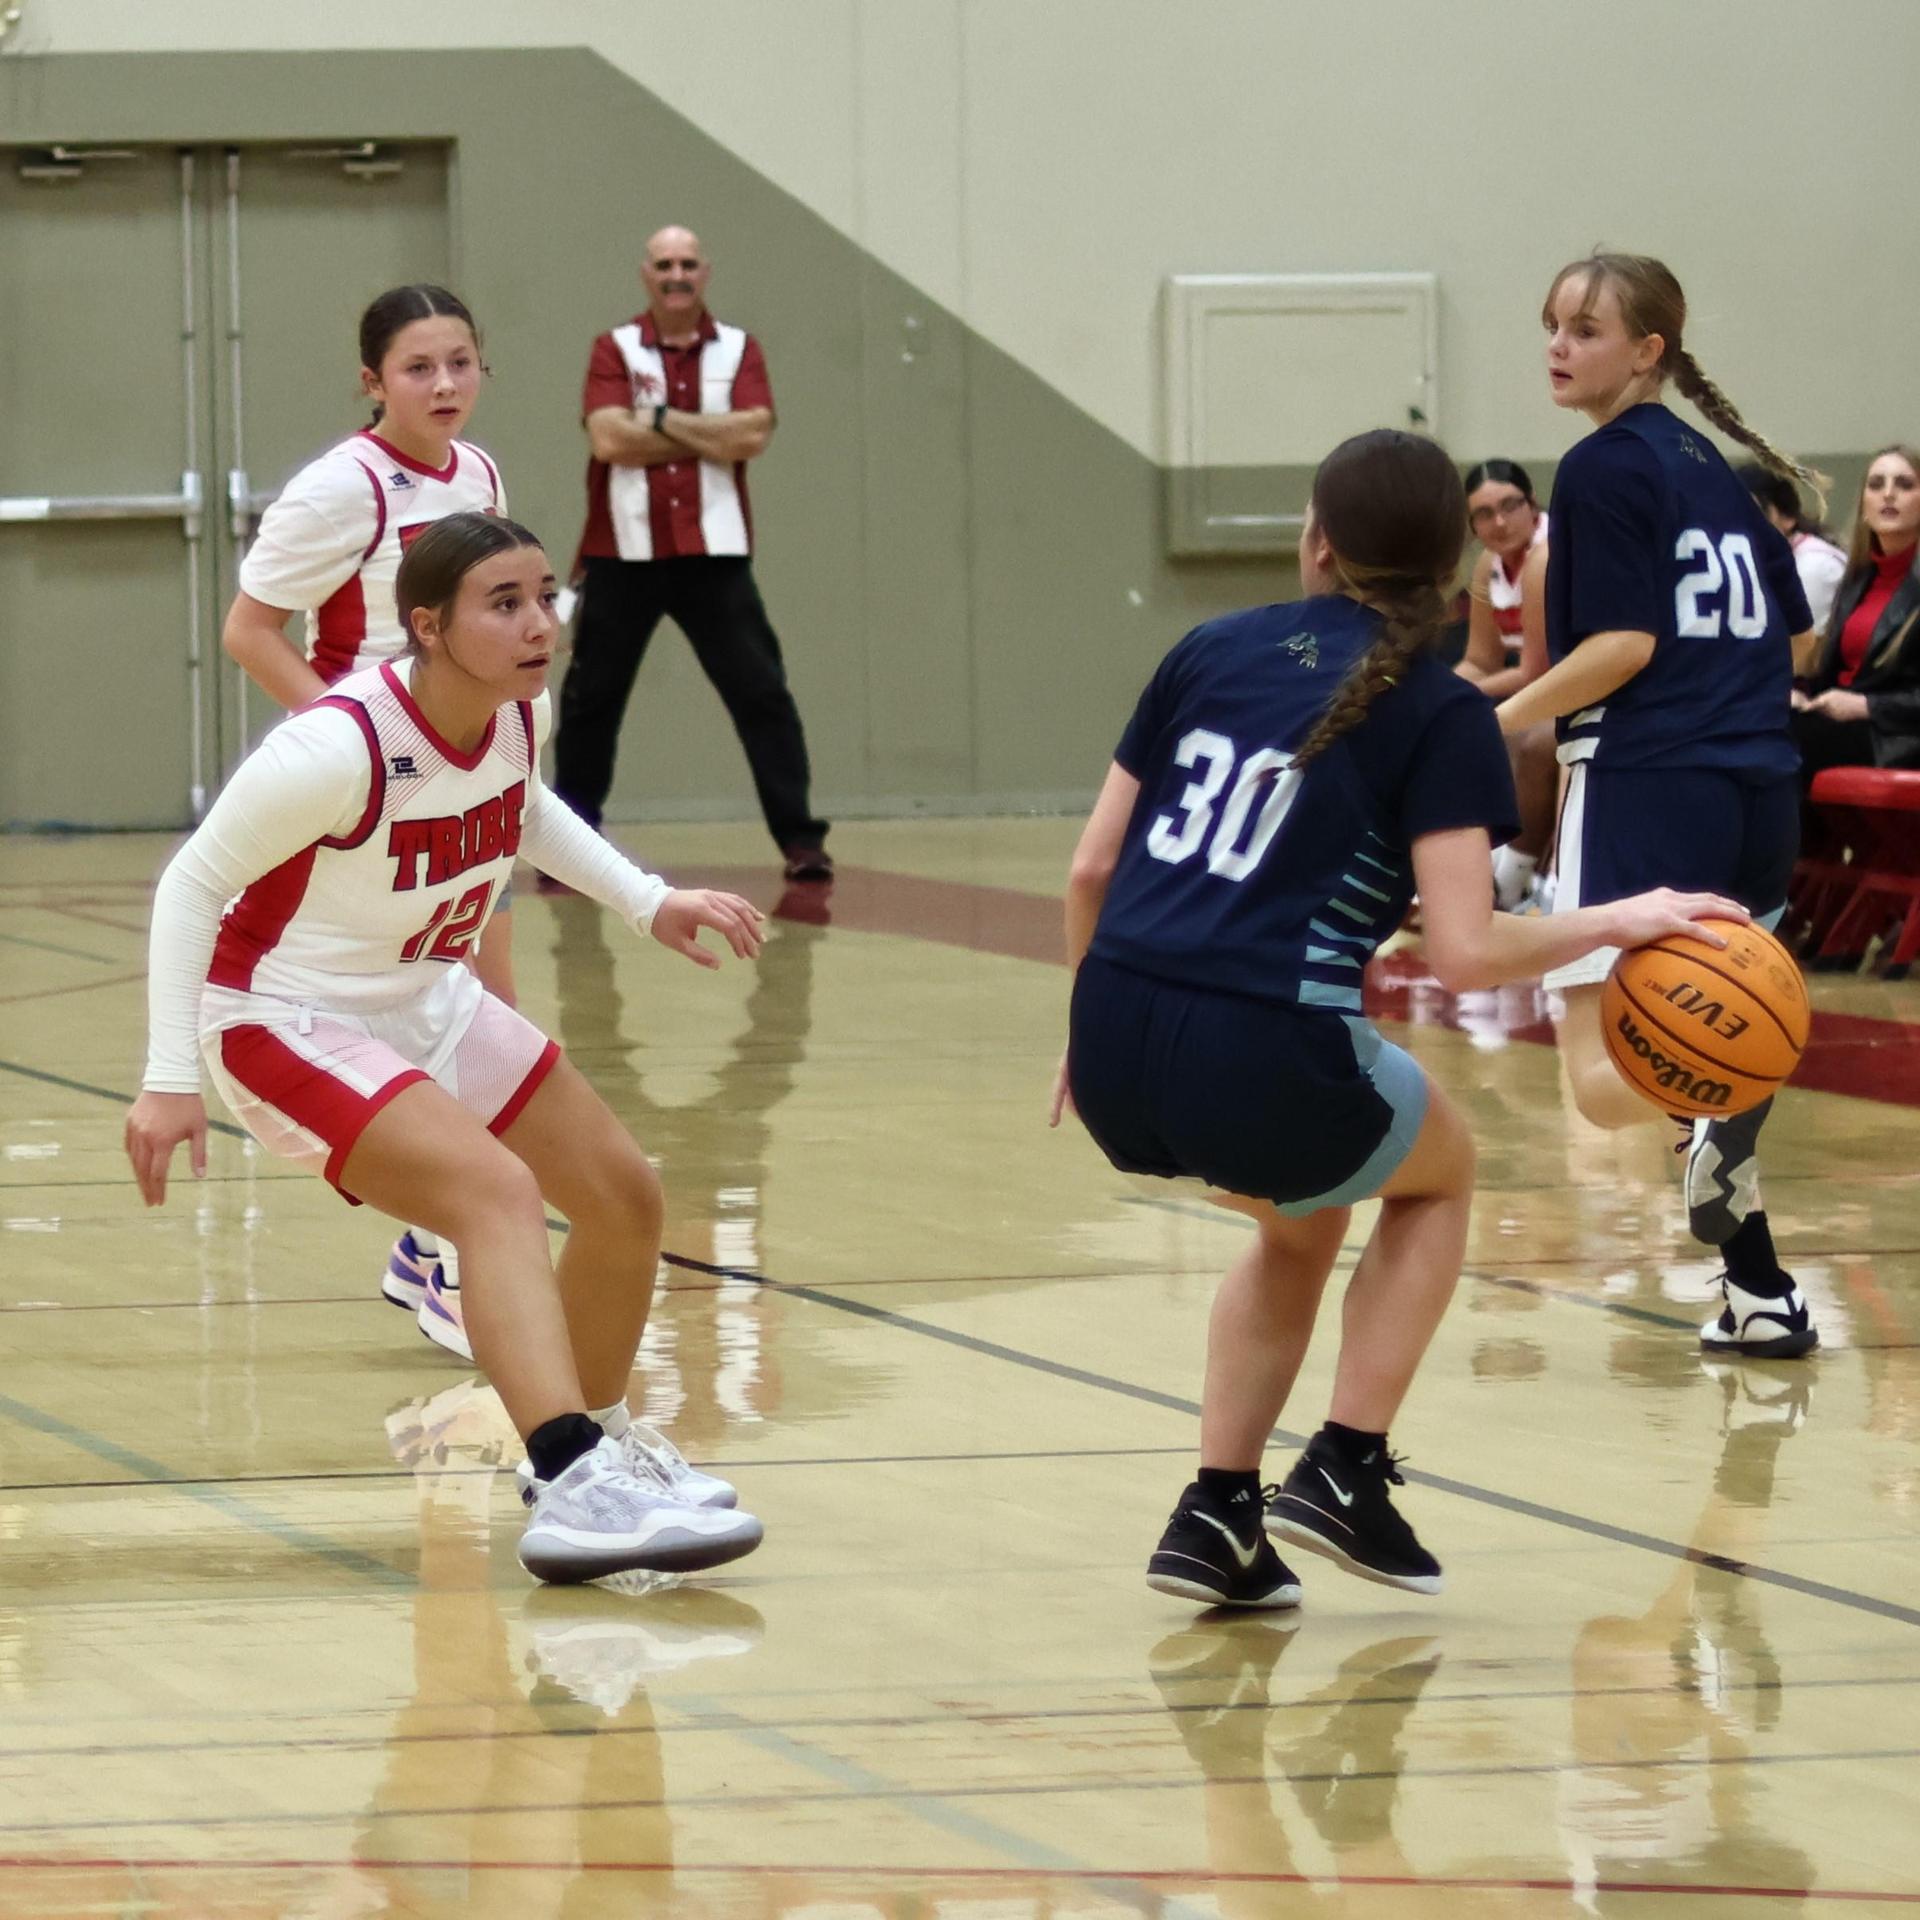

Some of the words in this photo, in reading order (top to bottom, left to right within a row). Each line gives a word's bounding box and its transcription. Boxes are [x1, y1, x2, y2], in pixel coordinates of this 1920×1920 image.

[1675, 529, 1768, 639] 20
[387, 778, 525, 892] TRIBE
[1147, 727, 1305, 882] 30
[399, 878, 495, 963] 12
[1617, 1010, 1732, 1106] Wilson
[1665, 982, 1750, 1040] EVO
